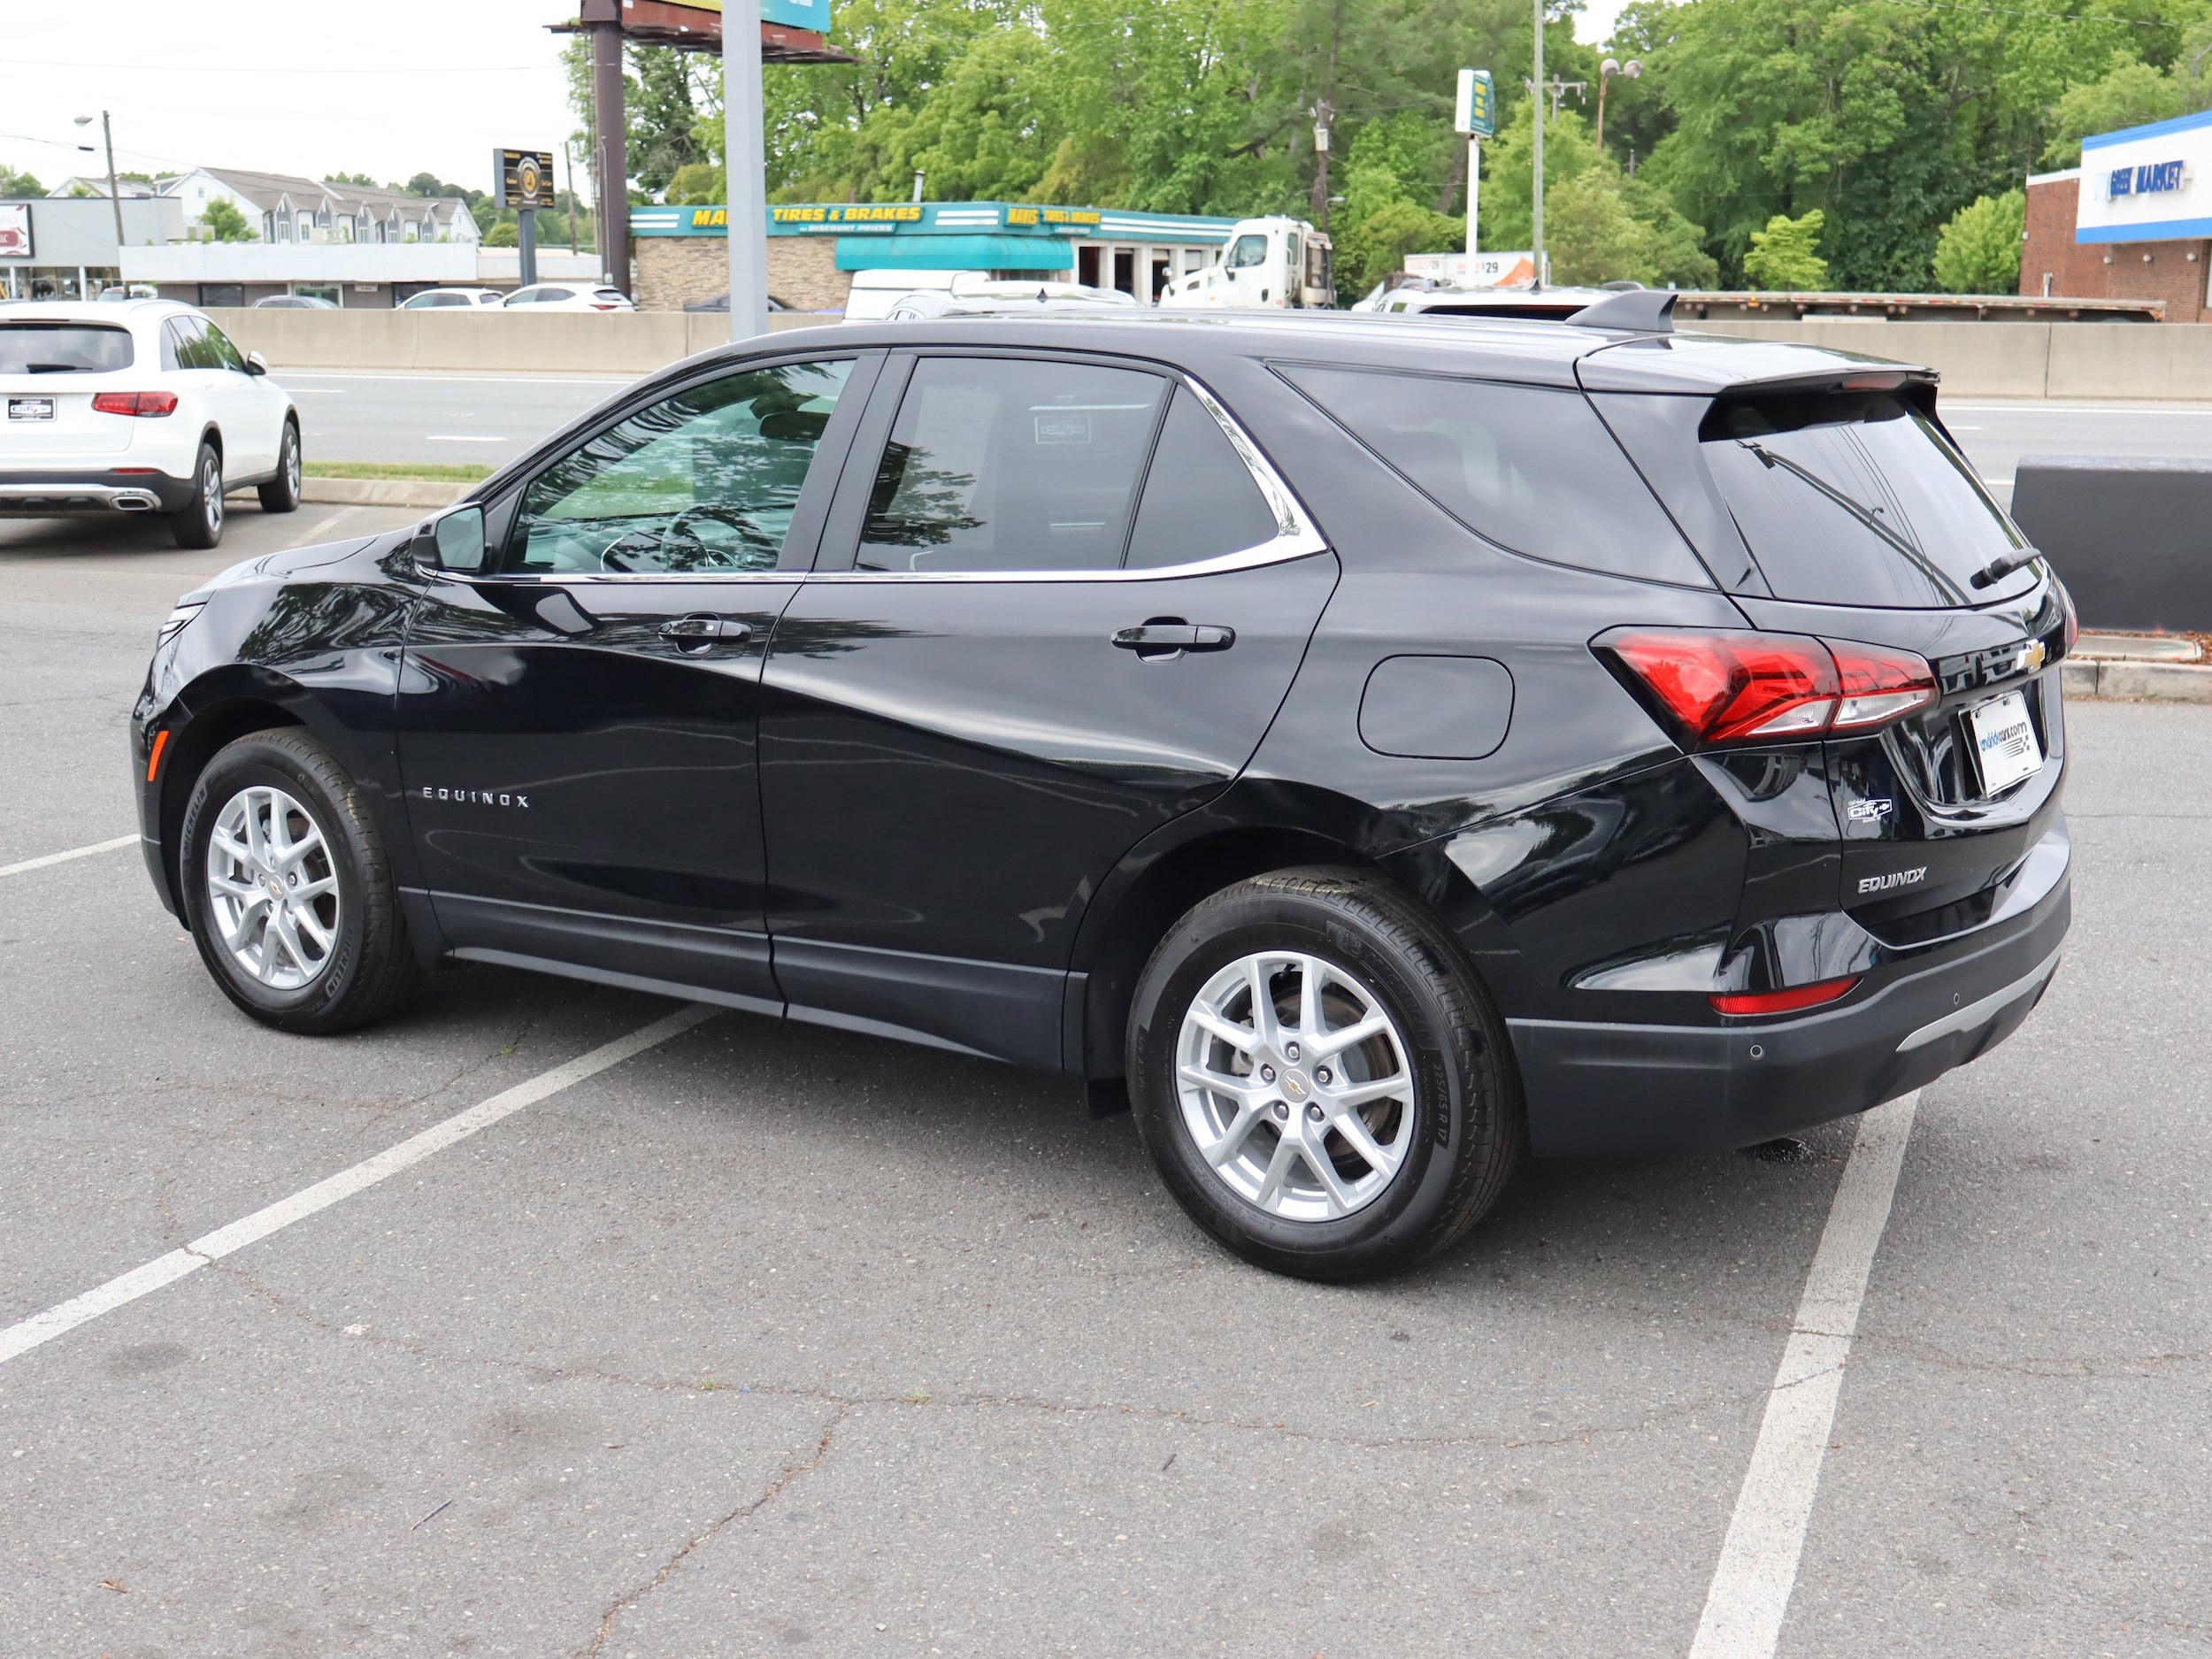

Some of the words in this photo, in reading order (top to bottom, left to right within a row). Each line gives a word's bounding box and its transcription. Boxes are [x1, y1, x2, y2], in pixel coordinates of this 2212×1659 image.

[2137, 160, 2184, 194] MARKET
[772, 208, 826, 221] TIRES
[828, 210, 840, 221] &
[843, 207, 922, 221] BRAKES
[423, 787, 528, 808] EQUINOX
[1850, 803, 1879, 818] City
[1858, 867, 1927, 894] EQUINOX
[1434, 1063, 1448, 1111] 225/65
[1439, 1113, 1448, 1124] R
[1437, 1127, 1448, 1142] 17
